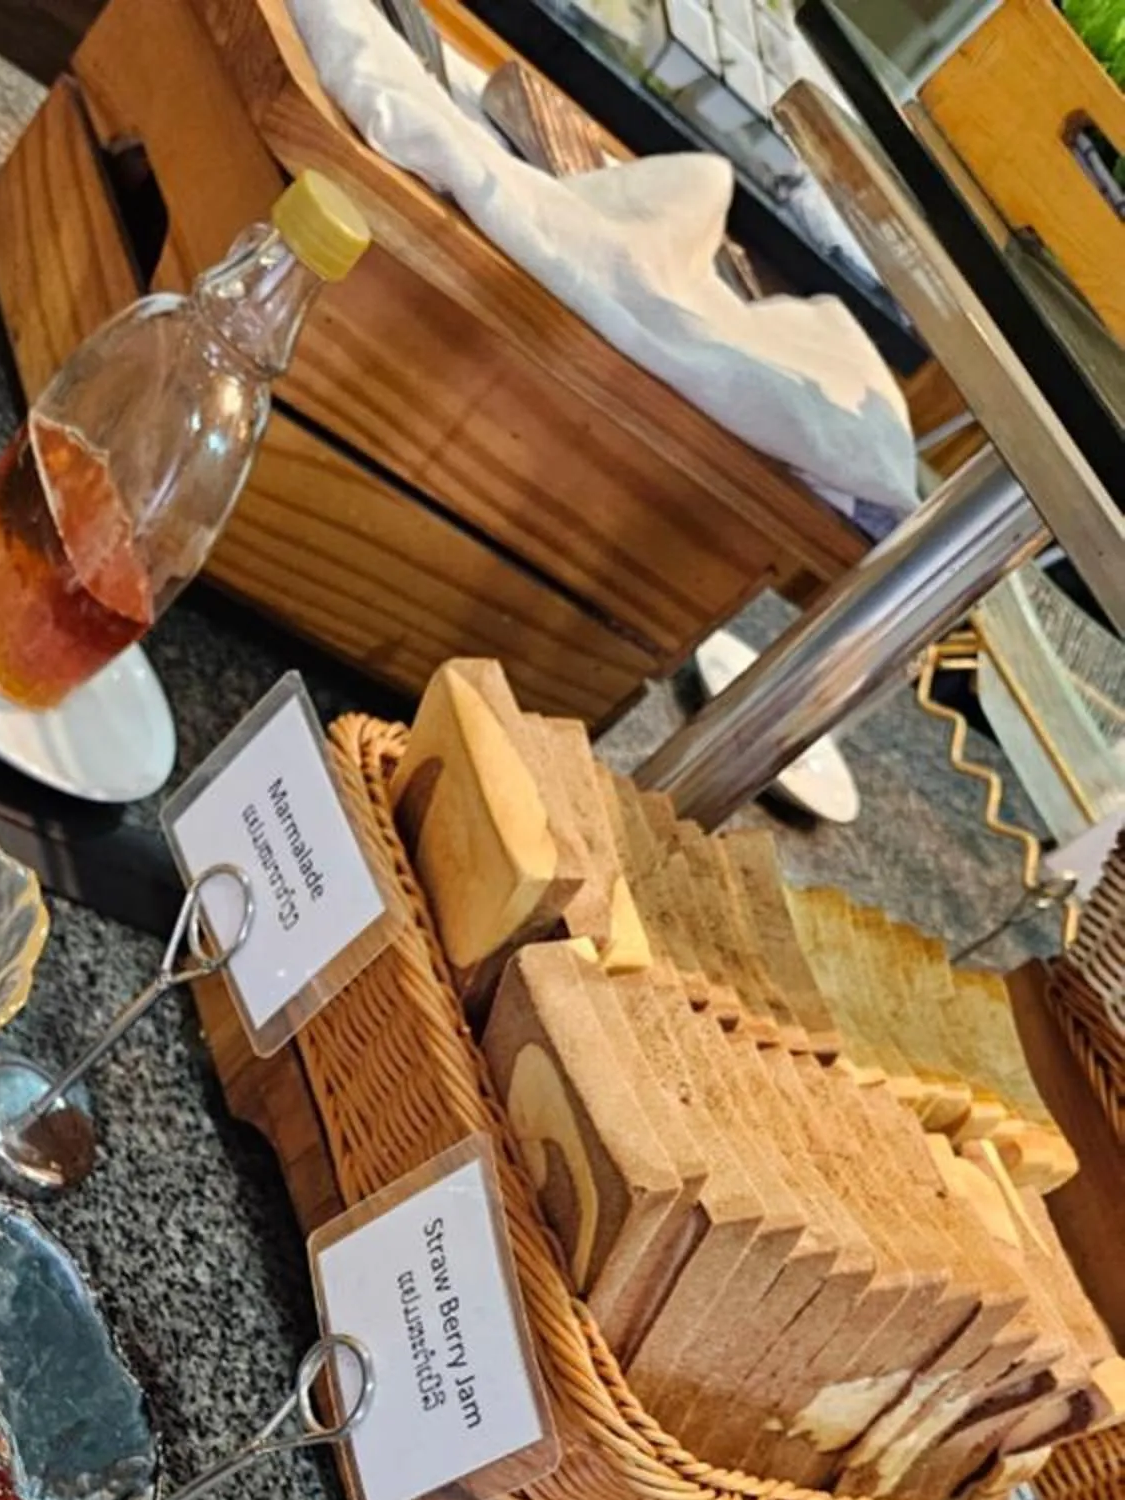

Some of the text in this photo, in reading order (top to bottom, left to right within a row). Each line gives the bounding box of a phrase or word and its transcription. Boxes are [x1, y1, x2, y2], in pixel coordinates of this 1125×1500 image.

[268, 777, 325, 902] Marmalade
[424, 1217, 482, 1429] Straw Berry Jam
